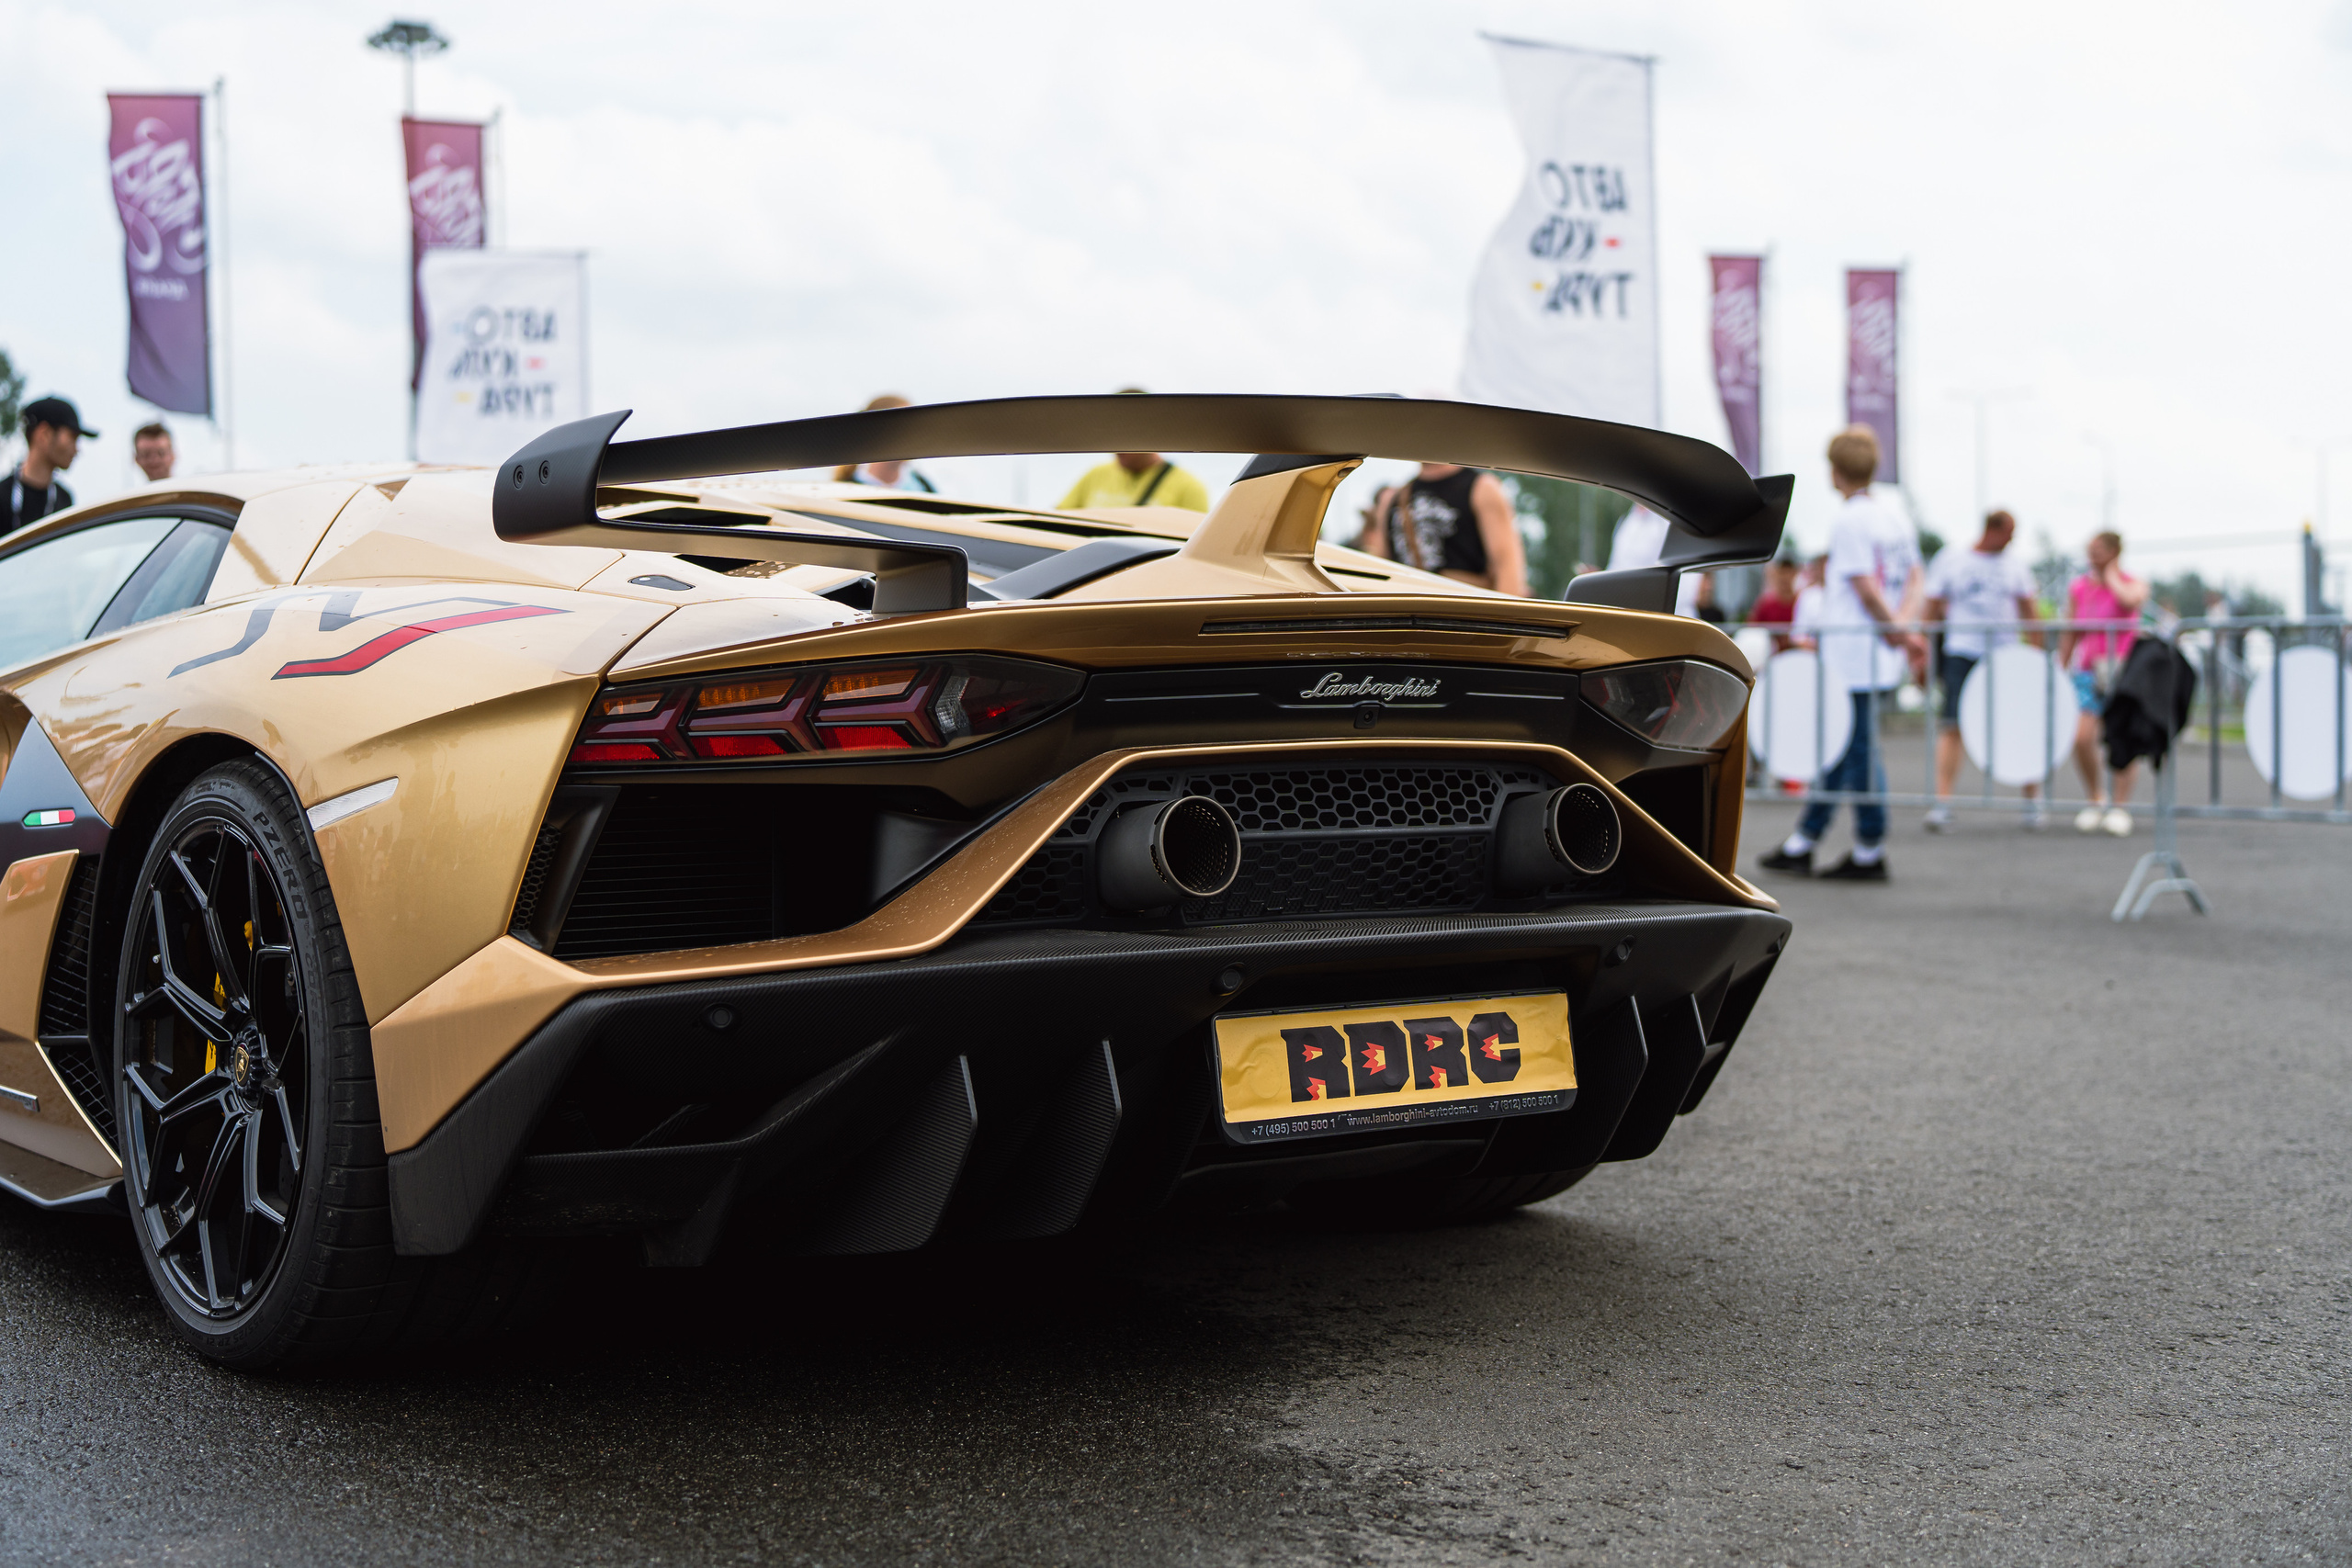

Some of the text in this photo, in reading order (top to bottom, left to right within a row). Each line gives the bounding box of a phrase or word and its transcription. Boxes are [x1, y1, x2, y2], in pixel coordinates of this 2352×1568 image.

[1300, 671, 1442, 701] Lamborghini
[1280, 1011, 1521, 1102] RDRC
[1489, 1094, 1558, 1111] +7 (812) 500 500 1
[1347, 1104, 1478, 1126] www.lamborghini-avtodom.ru
[1251, 1118, 1336, 1136] +7 (495) 500 500 1
